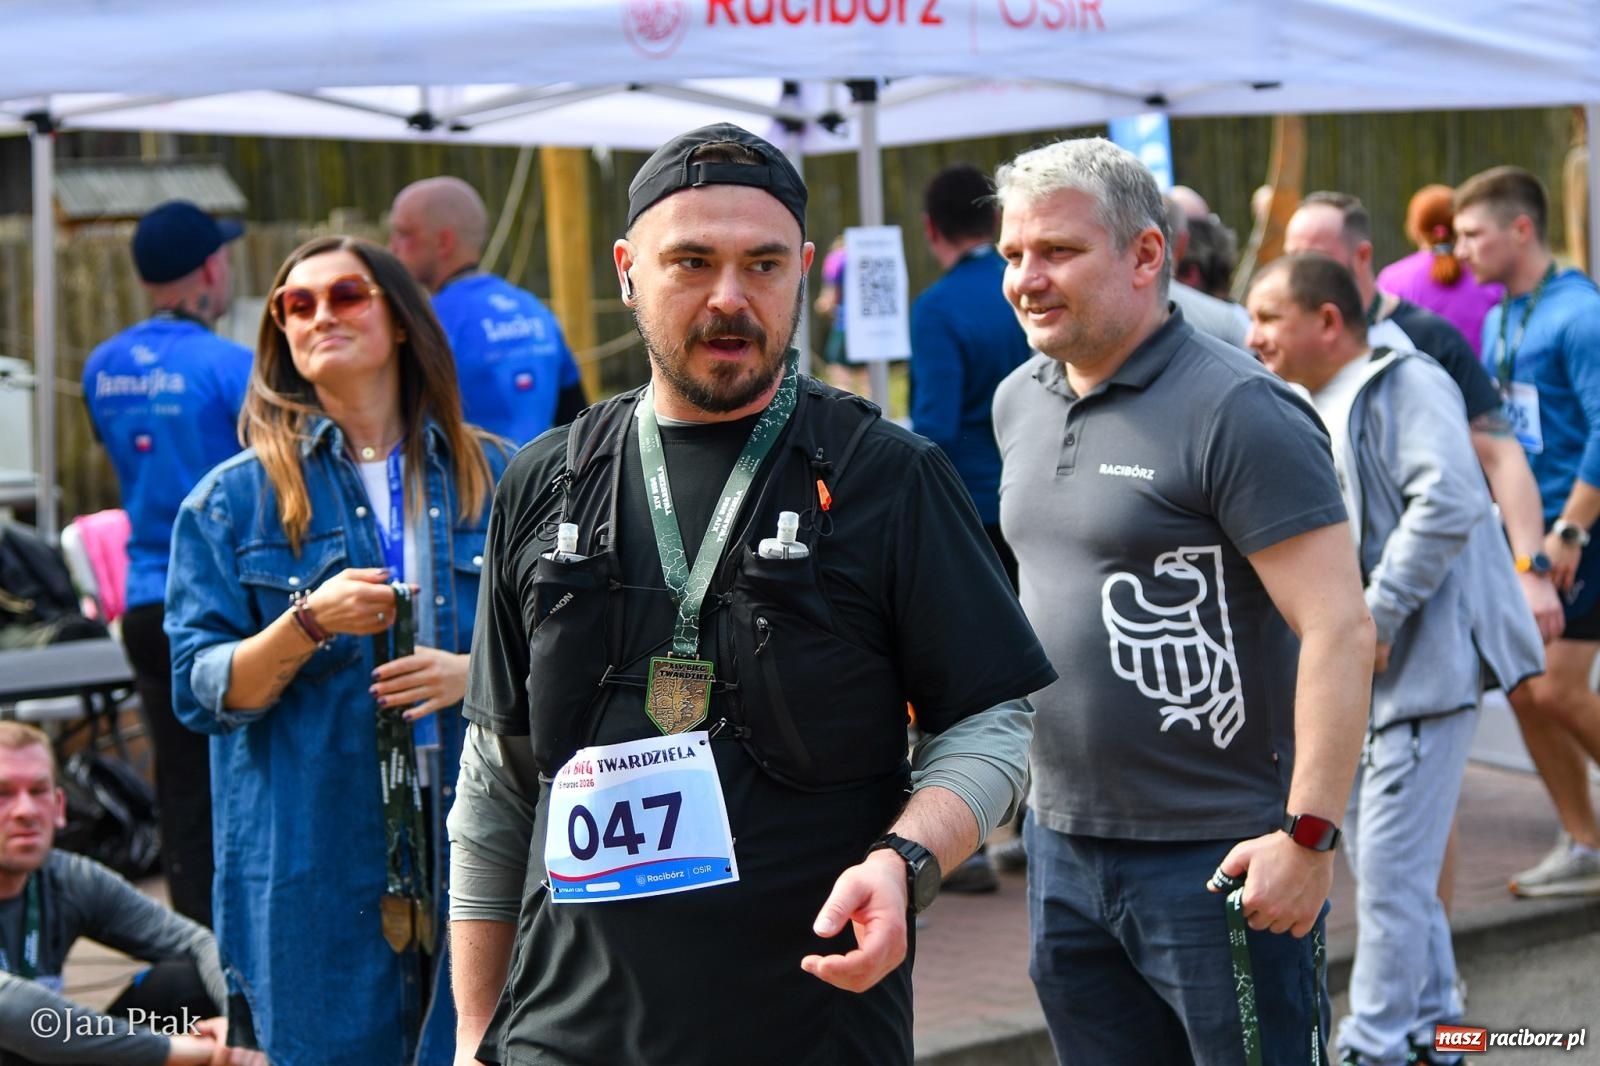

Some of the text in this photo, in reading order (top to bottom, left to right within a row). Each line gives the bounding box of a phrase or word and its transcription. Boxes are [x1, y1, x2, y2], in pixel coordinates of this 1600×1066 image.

[1099, 463, 1155, 480] RACIBÓRZ
[597, 746, 696, 773] TWARDZIELA
[568, 791, 683, 861] 047
[646, 864, 713, 883] Racibórz OSiR
